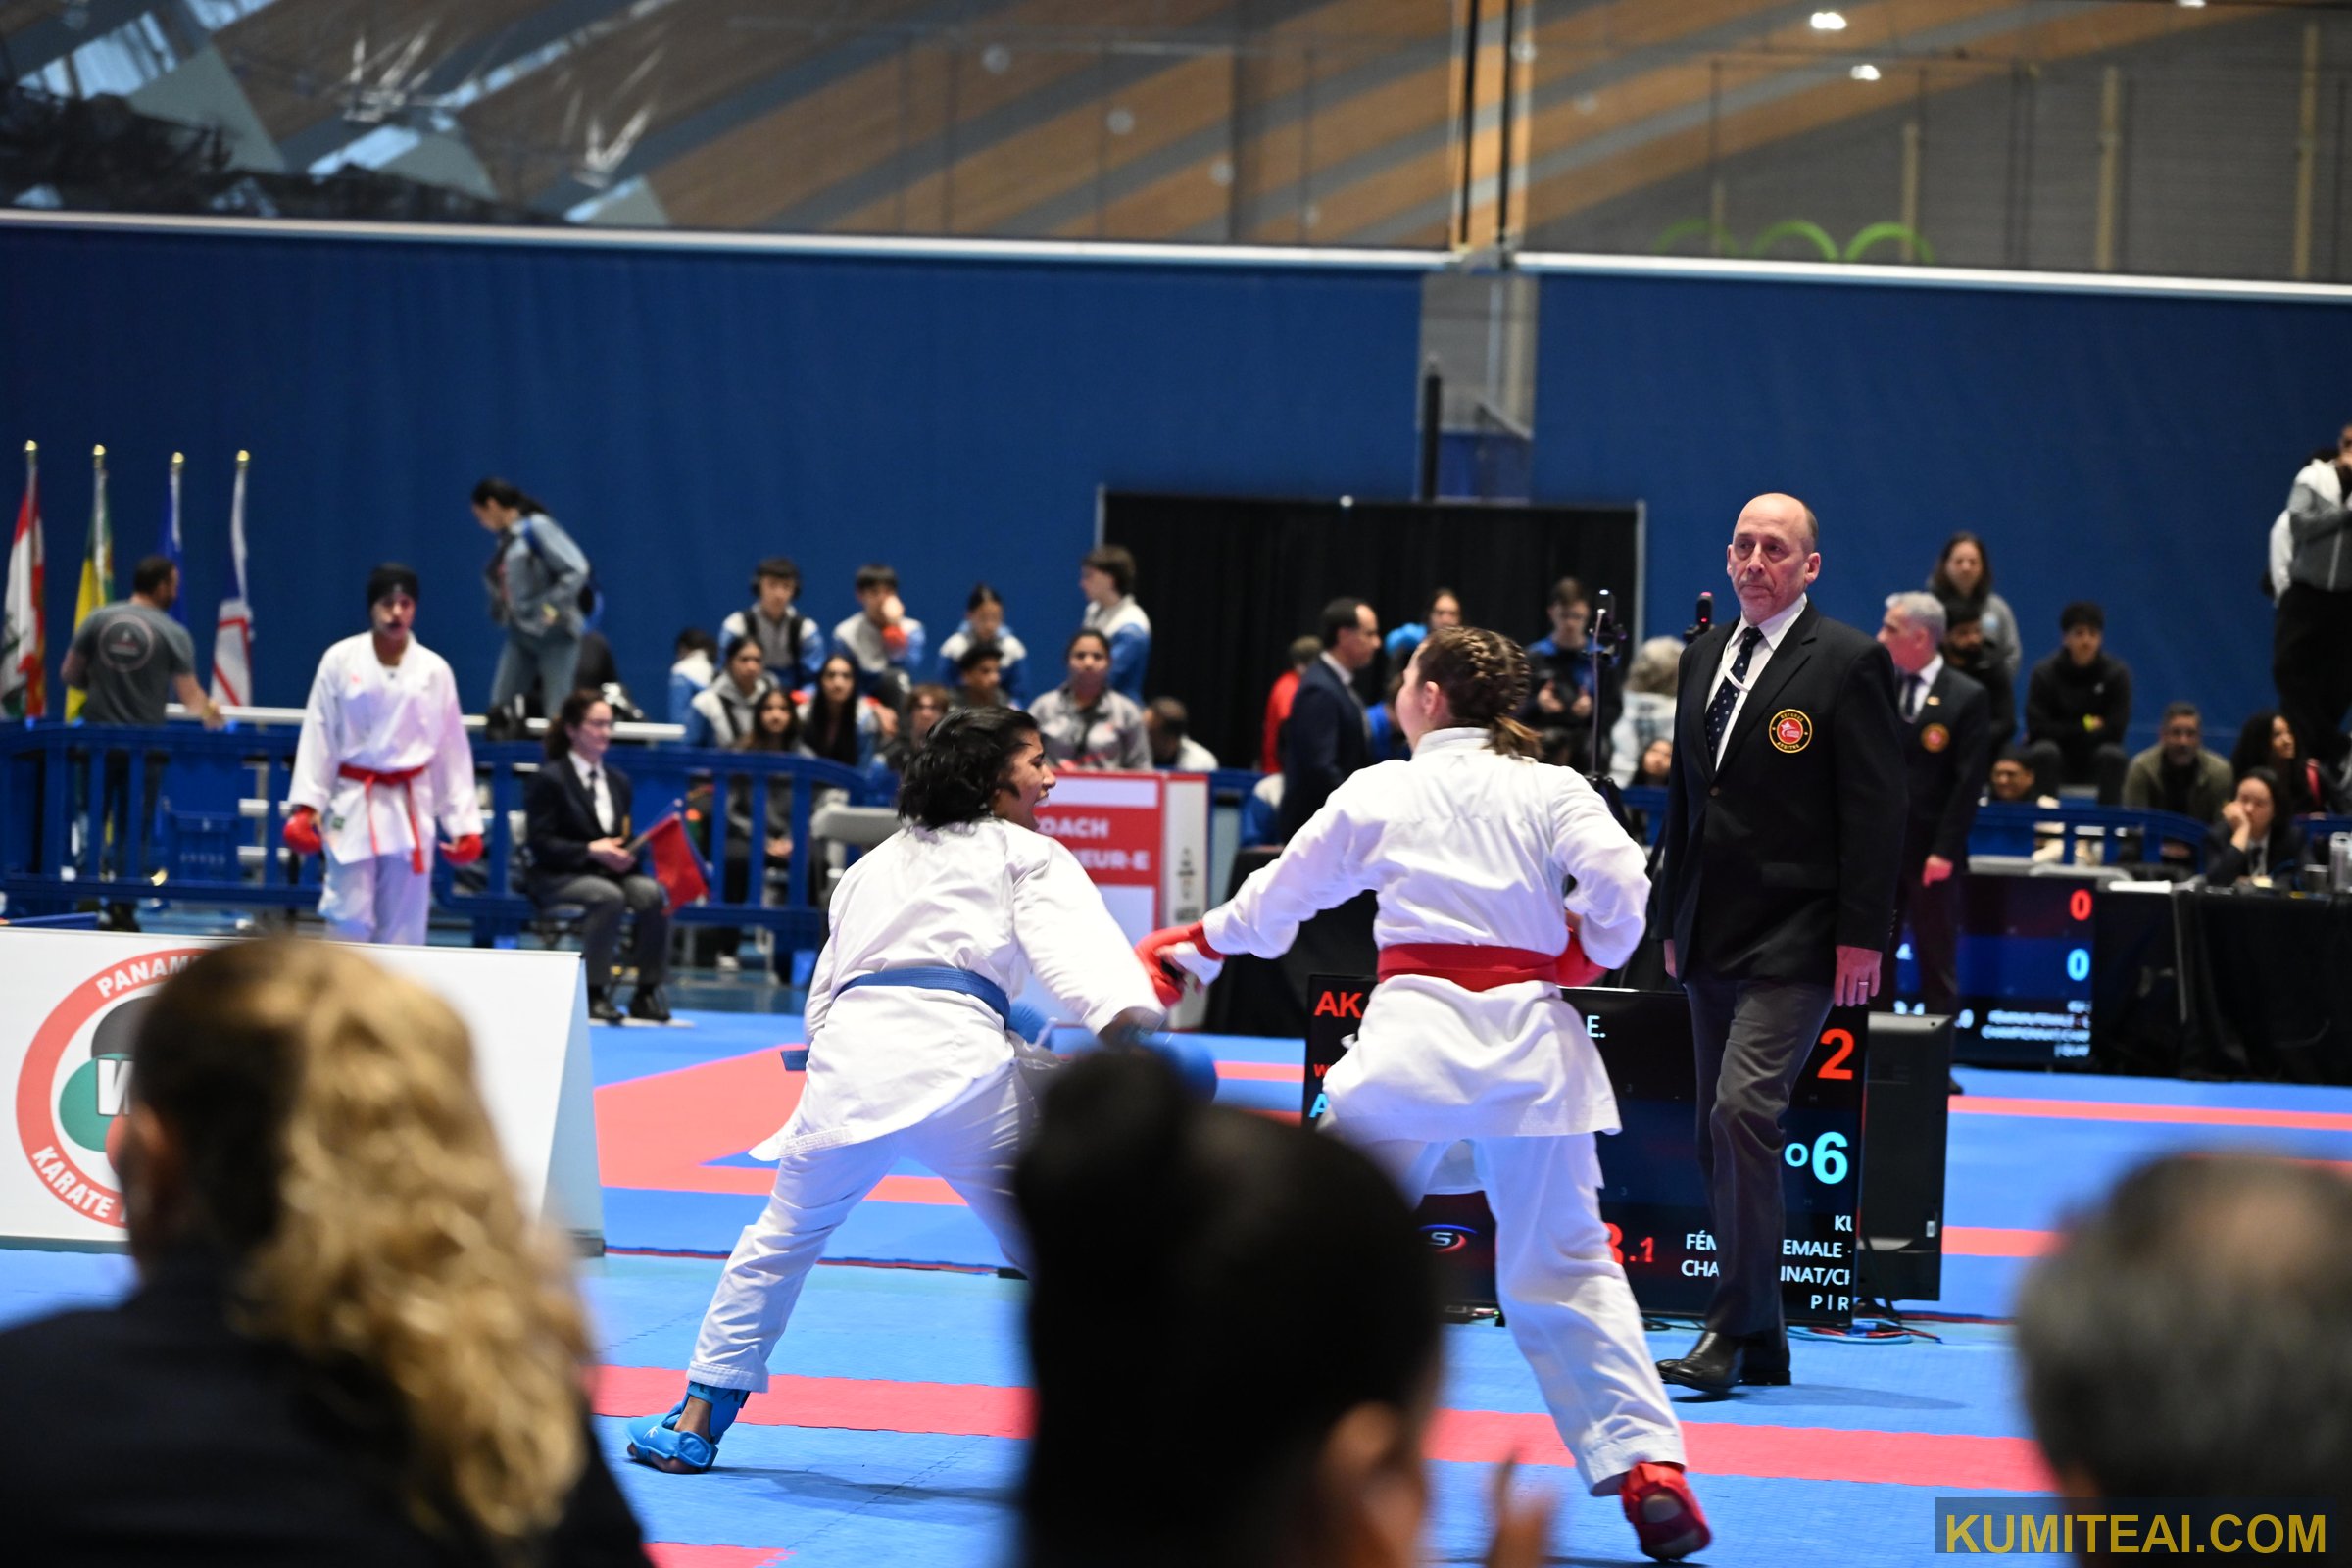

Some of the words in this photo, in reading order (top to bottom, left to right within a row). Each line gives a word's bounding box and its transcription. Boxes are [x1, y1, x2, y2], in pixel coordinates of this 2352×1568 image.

[1036, 815, 1109, 838] OACH
[2070, 889, 2092, 921] 0
[96, 955, 196, 998] PANAM
[2067, 948, 2090, 981] 0
[1314, 991, 1363, 1018] AK
[1587, 1015, 1606, 1038] E.
[1817, 1028, 1854, 1080] 2
[32, 1146, 115, 1218] KARATE
